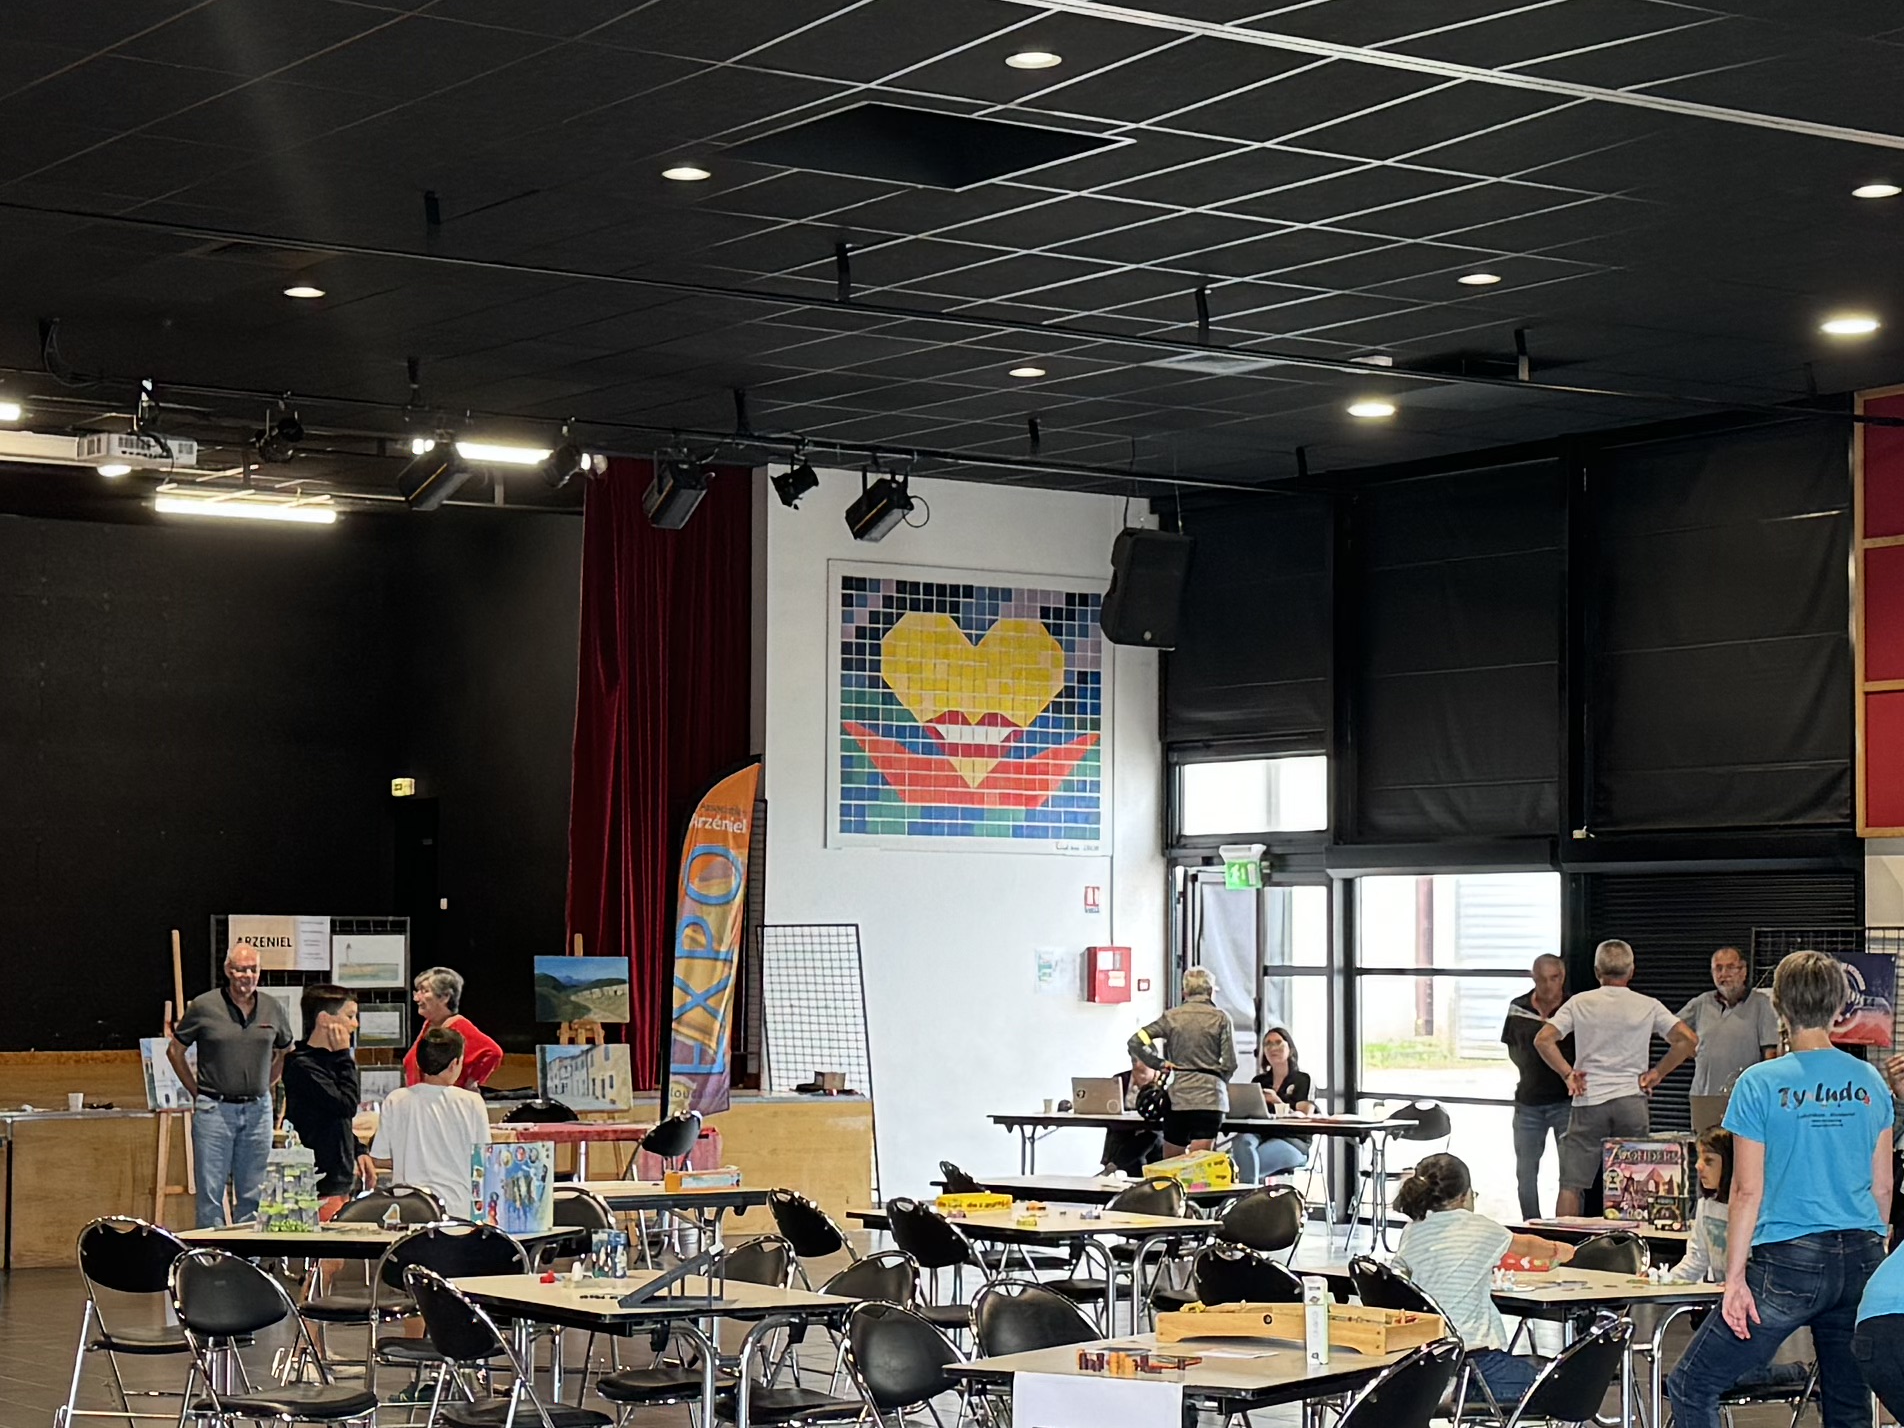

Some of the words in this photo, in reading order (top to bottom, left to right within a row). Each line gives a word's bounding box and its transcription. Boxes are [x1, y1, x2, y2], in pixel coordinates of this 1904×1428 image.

[669, 845, 743, 1074] EXPO
[1778, 1086, 1806, 1107] Ty
[1815, 1080, 1868, 1103] Ludo
